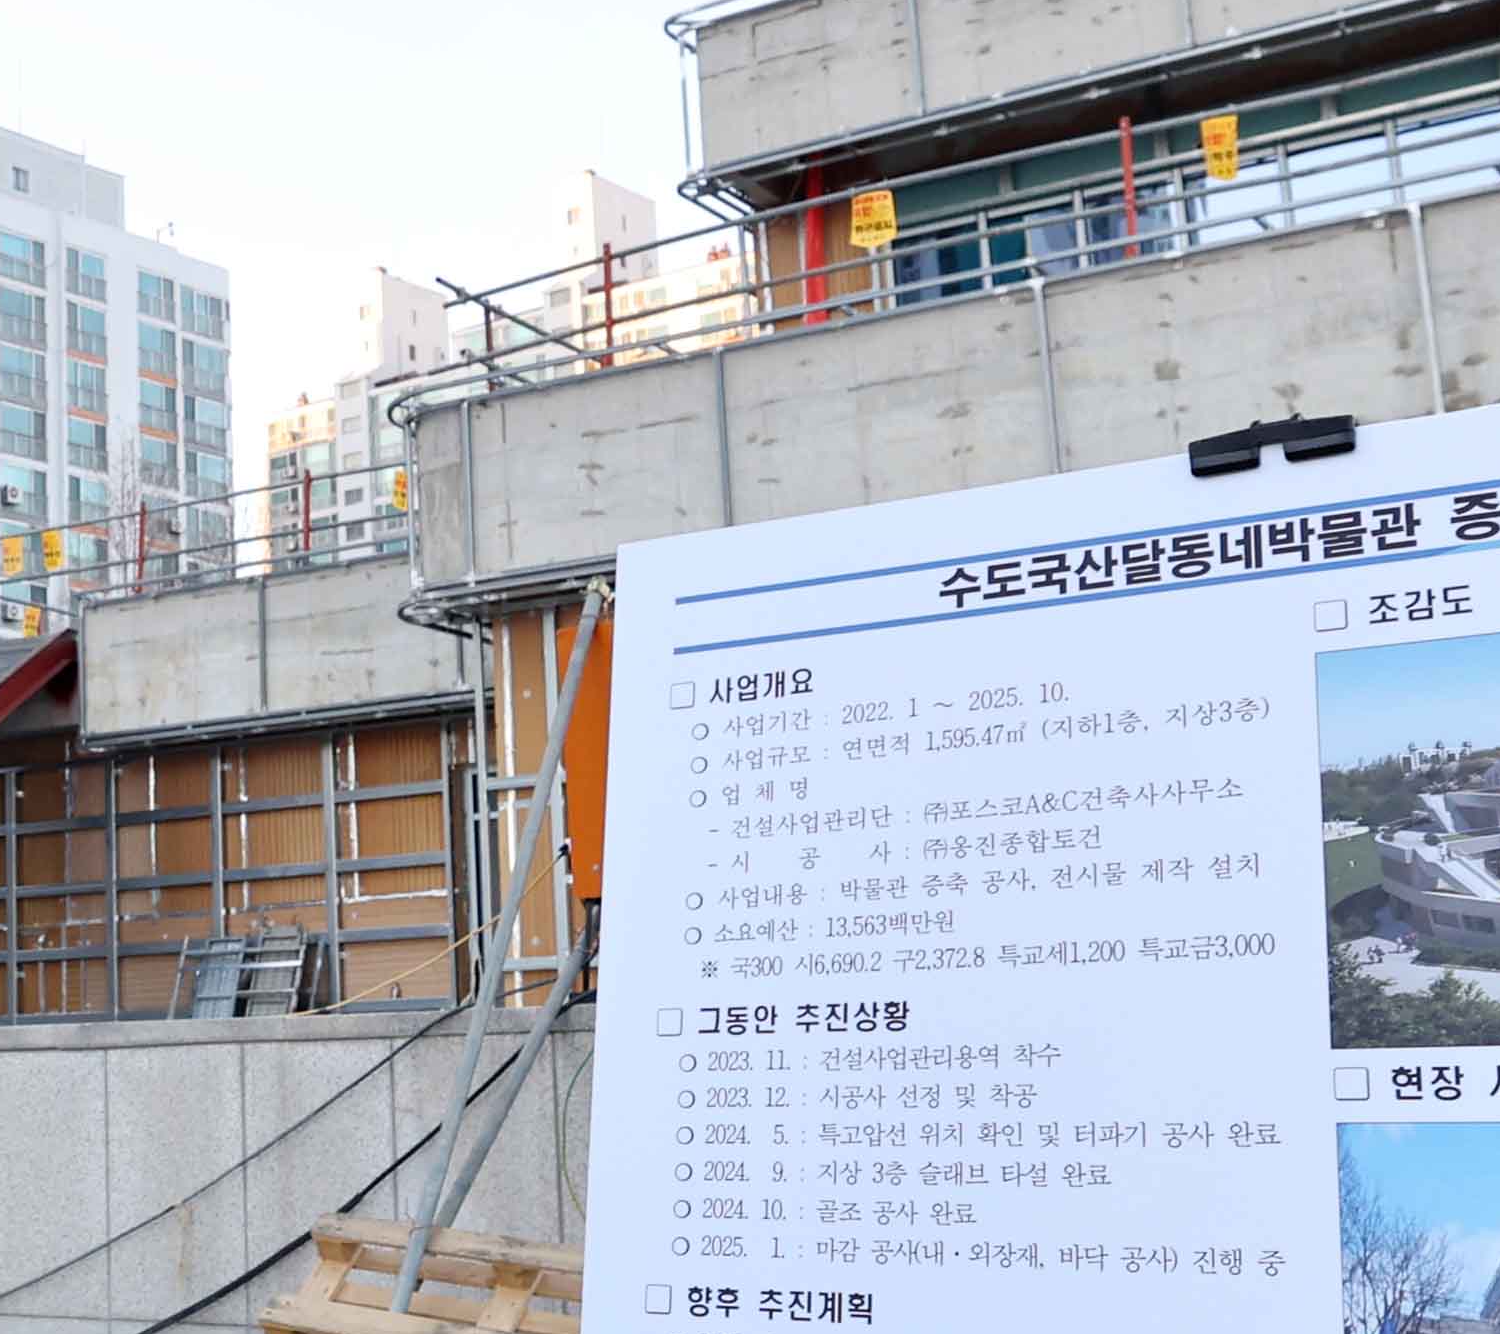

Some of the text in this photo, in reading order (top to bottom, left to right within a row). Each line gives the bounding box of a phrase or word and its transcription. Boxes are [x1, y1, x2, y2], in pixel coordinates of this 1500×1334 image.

[938, 502, 1422, 610] 수도국산달동네박물관
[1369, 584, 1474, 625] 조감도
[709, 668, 814, 704] 사업개요
[724, 708, 812, 738] 사업기간
[842, 701, 893, 725] 2022.
[909, 698, 918, 718] 1
[968, 687, 1023, 711] 2025.
[1040, 682, 1069, 703] 10.
[724, 746, 811, 771] 사업규모
[843, 732, 909, 760] 연면적
[1042, 710, 1148, 739] (지하1층,
[1165, 697, 1269, 728] 지상3층)
[732, 805, 893, 838] 건설사업관리단
[720, 883, 808, 910] 사업내용
[841, 875, 909, 902] 박물관
[922, 872, 968, 897] 증축
[1051, 862, 1126, 889] 전시물
[1142, 857, 1194, 883] 제작
[1208, 852, 1259, 879] 설치
[714, 918, 799, 942] 소요예산
[730, 956, 783, 979] 국300
[698, 1000, 910, 1036] 그동안 추진상황
[707, 1051, 753, 1072] 2023.
[766, 1049, 791, 1071] 11.
[820, 1044, 998, 1071] 건설사업관리용역
[1014, 1043, 1061, 1067] 착수
[706, 1087, 752, 1108] 2023.
[765, 1087, 790, 1107] 12.
[820, 1084, 886, 1110] 시공사
[896, 1083, 940, 1109] 선정
[955, 1083, 976, 1109] 및
[989, 1083, 1038, 1109] 착공
[1390, 1065, 1464, 1101] 현장
[704, 1123, 751, 1145] 2024.
[773, 1124, 789, 1145] 5.
[818, 1122, 907, 1147] 특고압선
[920, 1122, 963, 1147] 위치
[977, 1122, 1024, 1147] 확인
[1038, 1121, 1059, 1148] 및
[1074, 1121, 1146, 1147] 터파기
[1161, 1121, 1215, 1149] 공사
[1227, 1121, 1282, 1147] 완료
[704, 1160, 750, 1182] 2024.
[772, 1161, 787, 1182] 9.
[818, 1160, 862, 1185] 지상
[872, 1161, 908, 1186] 3층
[919, 1161, 989, 1187] 슬래브
[1000, 1161, 1048, 1187] 타설
[1061, 1162, 1112, 1187] 완료
[702, 1198, 749, 1219] 2024.
[762, 1199, 786, 1221] 10.
[816, 1200, 862, 1223] 골조
[872, 1200, 919, 1226] 공사
[930, 1200, 976, 1226] 완료
[700, 1235, 747, 1258] 2025.
[771, 1236, 784, 1259] 1.
[816, 1237, 861, 1263] 마감
[1059, 1244, 1109, 1272] 바닥
[1120, 1245, 1178, 1274] 공사)
[1193, 1247, 1242, 1275] 진행
[1257, 1251, 1286, 1277] 중
[688, 1285, 873, 1325] 향후 추진계획
